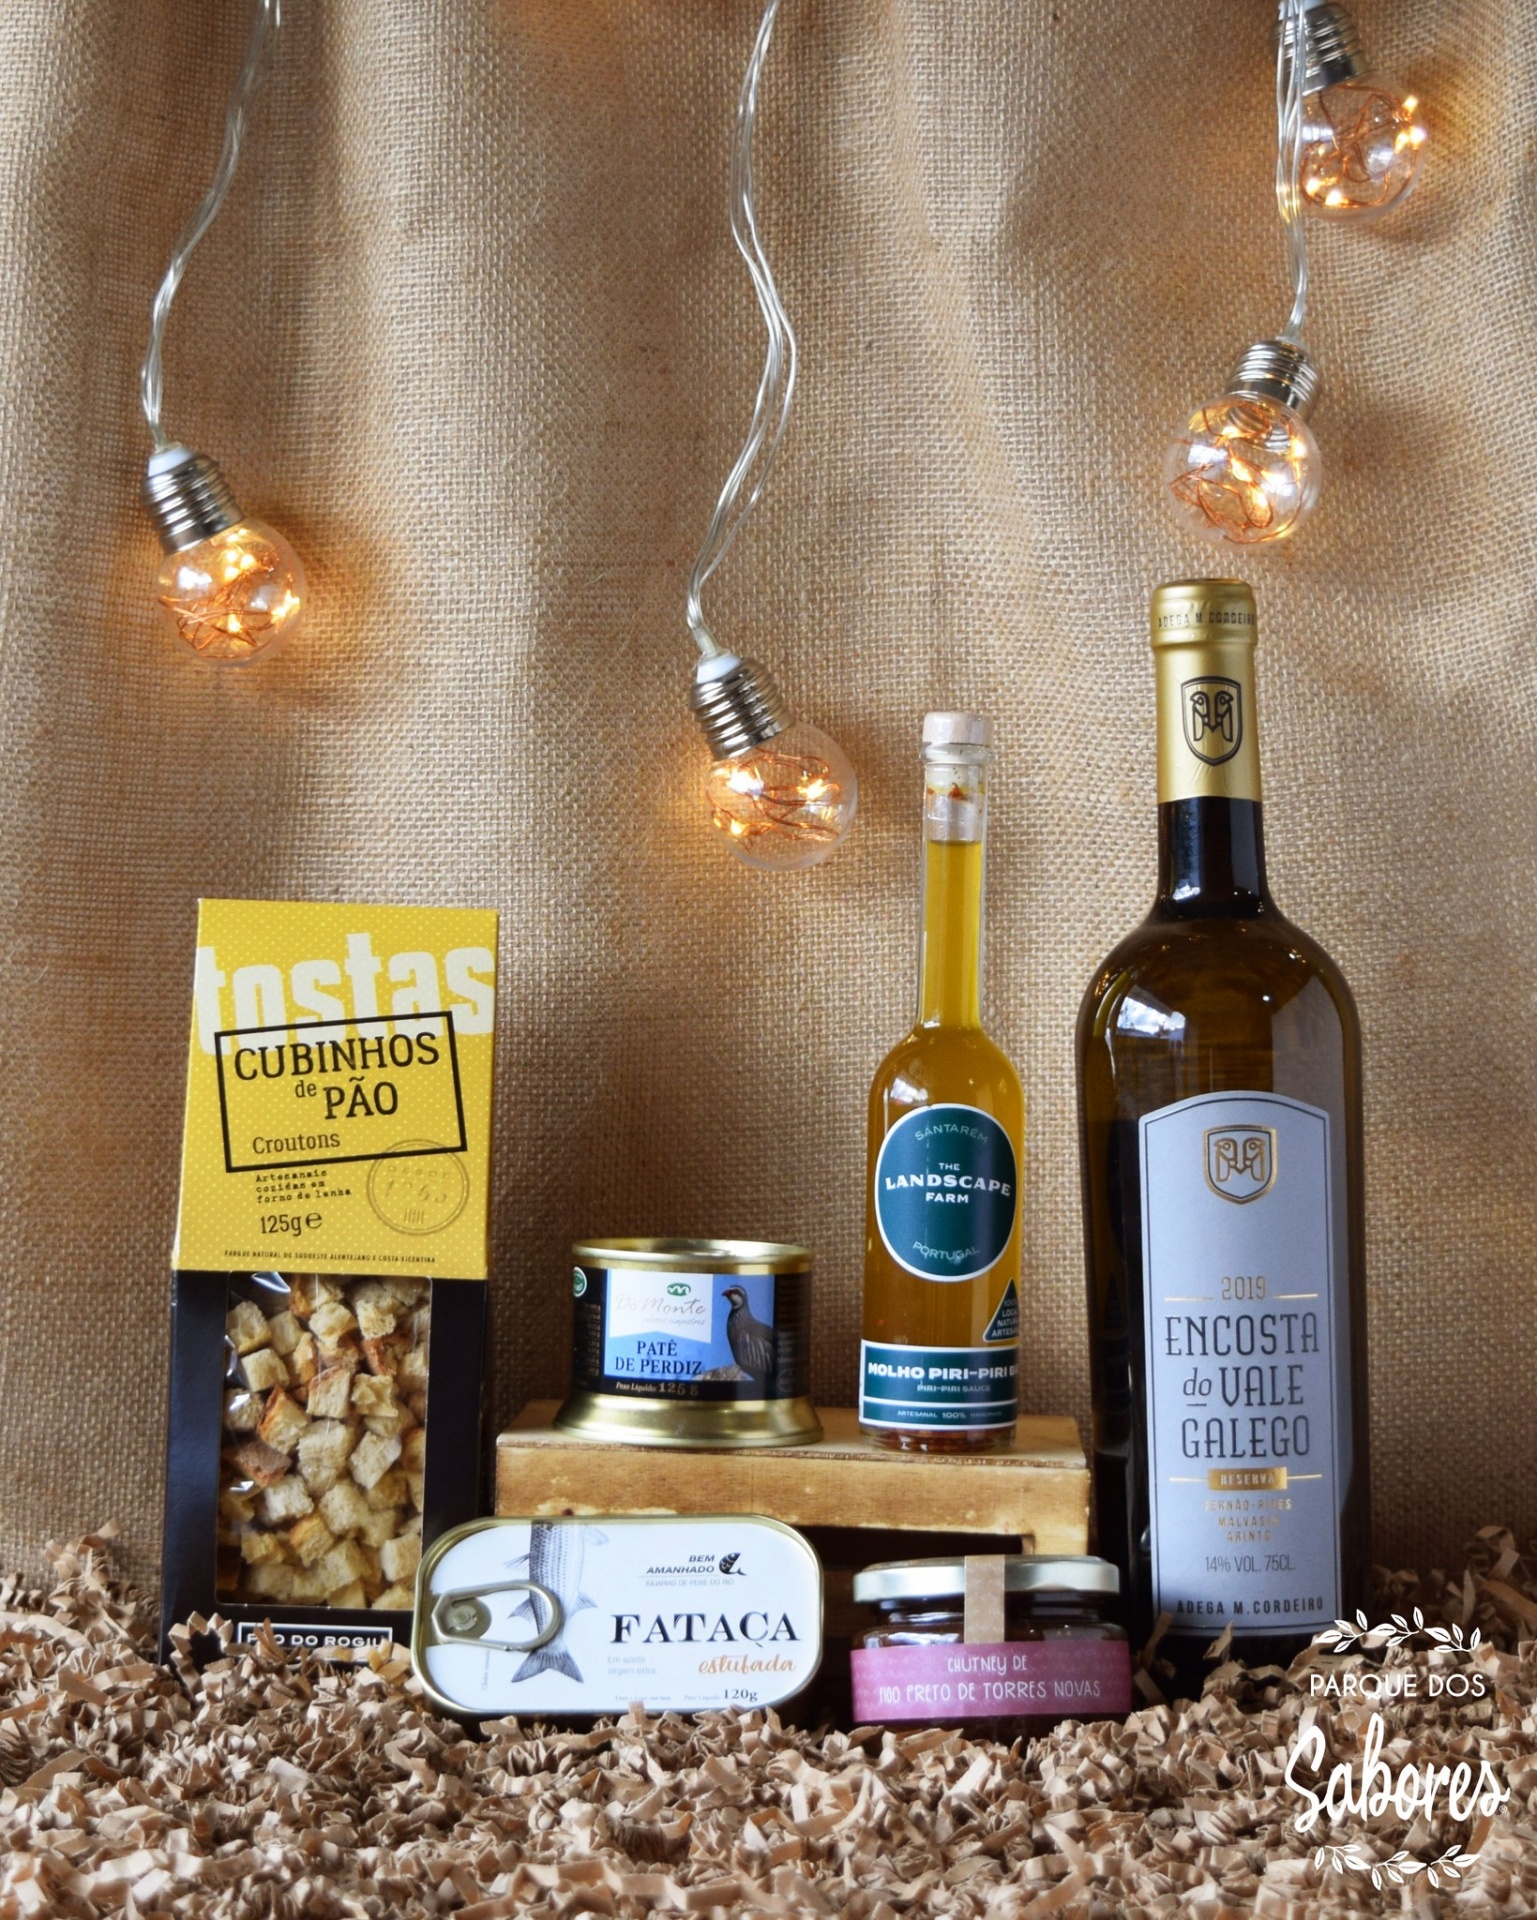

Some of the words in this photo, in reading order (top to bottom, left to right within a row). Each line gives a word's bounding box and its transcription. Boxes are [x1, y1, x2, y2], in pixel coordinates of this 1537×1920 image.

[1158, 613, 1190, 628] ADEGA
[194, 932, 495, 1055] tostas
[234, 1031, 440, 1081] CUBINHOS
[294, 1080, 317, 1098] de
[324, 1076, 399, 1120] PÃO
[915, 1123, 988, 1143] SANTARÉM
[252, 1133, 341, 1155] Croutons
[256, 1169, 327, 1182] Artesanais
[939, 1162, 960, 1171] THE
[256, 1182, 306, 1193] cozidas
[311, 1180, 326, 1188] em
[885, 1174, 1011, 1197] LANDSCAPE
[257, 1194, 292, 1204] forno
[297, 1191, 311, 1200] de
[316, 1188, 351, 1199] lenha
[925, 1192, 969, 1203] FARM
[912, 1241, 980, 1262] PORTUGAL
[1221, 1275, 1267, 1300] 2019
[639, 1298, 706, 1315] Monte
[1164, 1311, 1320, 1357] ENCOSTA
[636, 1338, 678, 1357] PATÊ
[615, 1356, 635, 1372] DE
[640, 1358, 702, 1376] PERDIZ
[867, 1362, 925, 1379] MOLHO
[928, 1365, 1008, 1380] PIRI-PIRI
[917, 1384, 960, 1392] PIRI-PIRI
[962, 1384, 991, 1392] SAUCE
[1182, 1366, 1212, 1397] do
[1218, 1364, 1304, 1408] VALE
[896, 1410, 938, 1418] ARTESANAL
[942, 1411, 966, 1419] 100%
[1181, 1415, 1310, 1459] GALEGO
[1220, 1473, 1275, 1486] RESERVA
[1226, 1530, 1271, 1543] ARINTO
[688, 1554, 715, 1563] BEM
[1205, 1555, 1231, 1573] 14%
[646, 1565, 715, 1574] AMANHADO
[1177, 1600, 1225, 1614] ADEGA
[609, 1610, 801, 1648] FATAÇA
[246, 1633, 285, 1645] PO
[291, 1635, 318, 1646] DO
[324, 1636, 380, 1648] ROGIL
[698, 1653, 796, 1675] estufada
[947, 1655, 1007, 1676] CHUTNEY
[1012, 1655, 1028, 1671] DE
[723, 1688, 758, 1702] 120g
[906, 1683, 951, 1702] PRETO
[957, 1682, 976, 1701] DE
[983, 1681, 1047, 1699] TORRES
[1054, 1680, 1101, 1698] NOVAS
